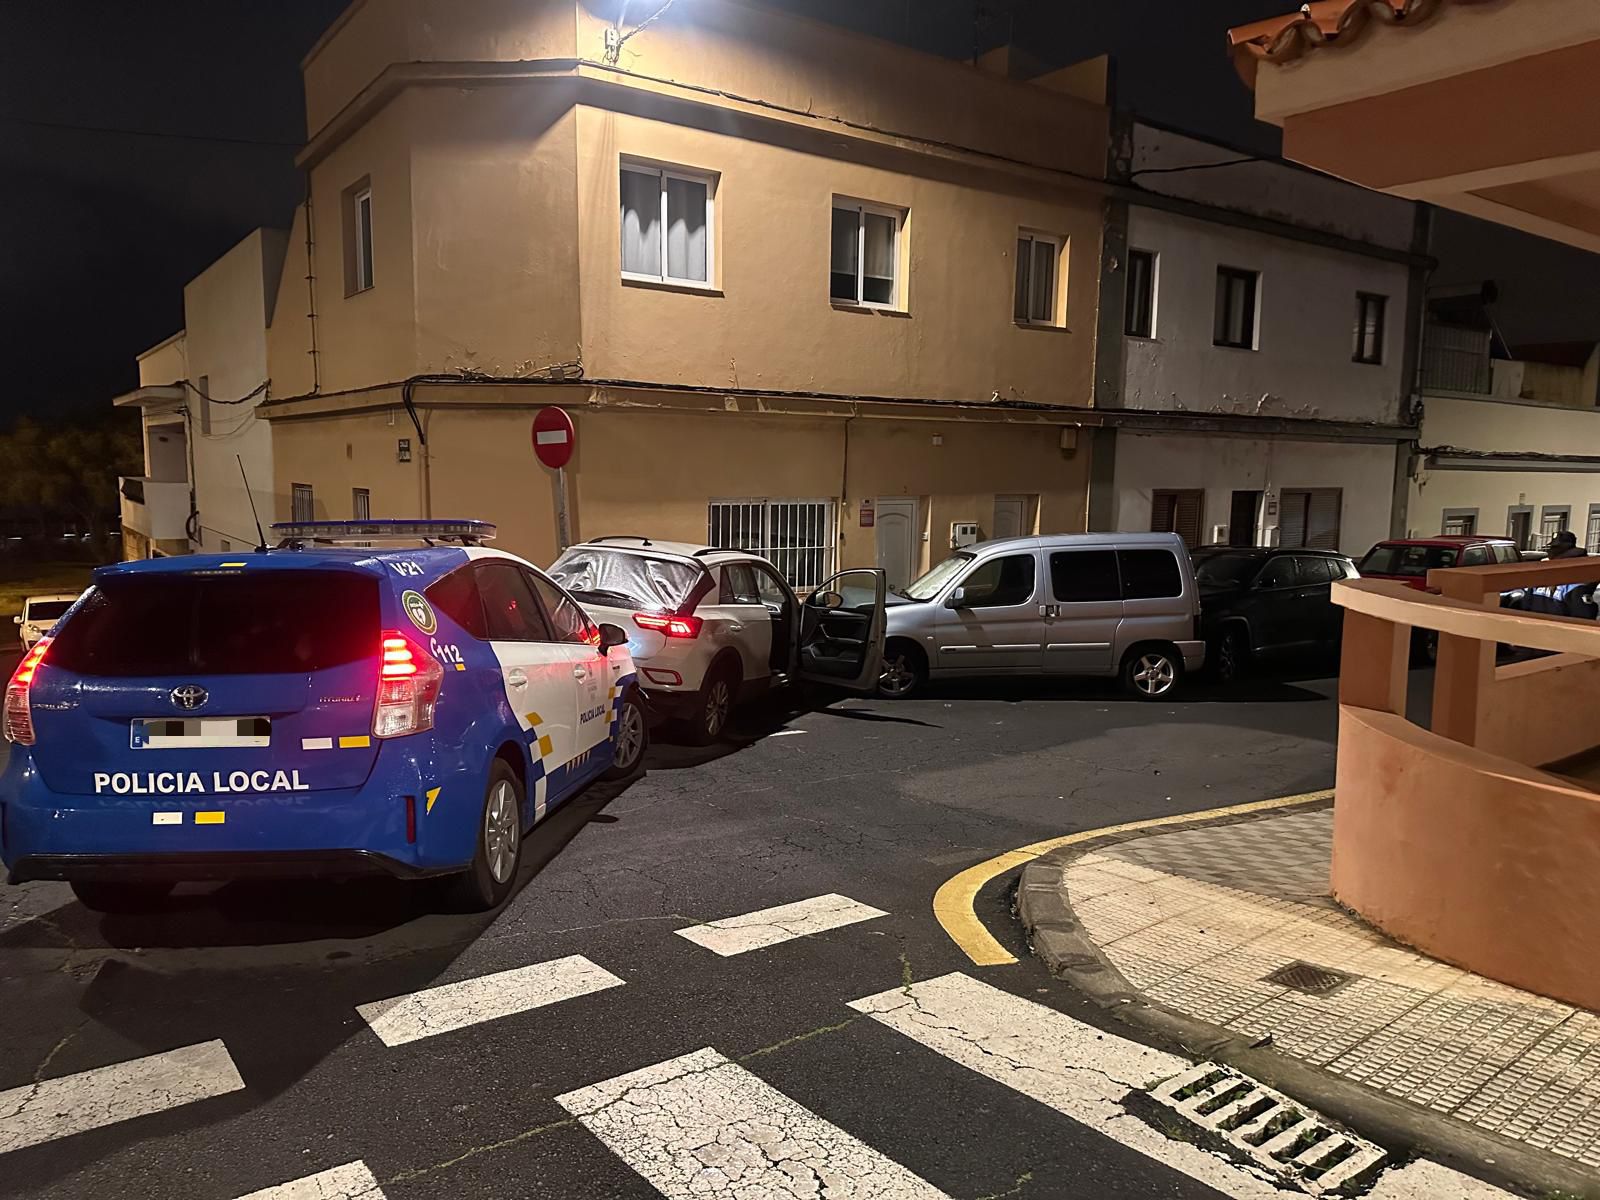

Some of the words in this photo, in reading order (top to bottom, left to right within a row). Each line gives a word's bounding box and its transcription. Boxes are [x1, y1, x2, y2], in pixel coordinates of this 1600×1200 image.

[134, 736, 140, 744] E
[94, 772, 205, 794] POLICIA
[213, 769, 309, 792] LOCAL
